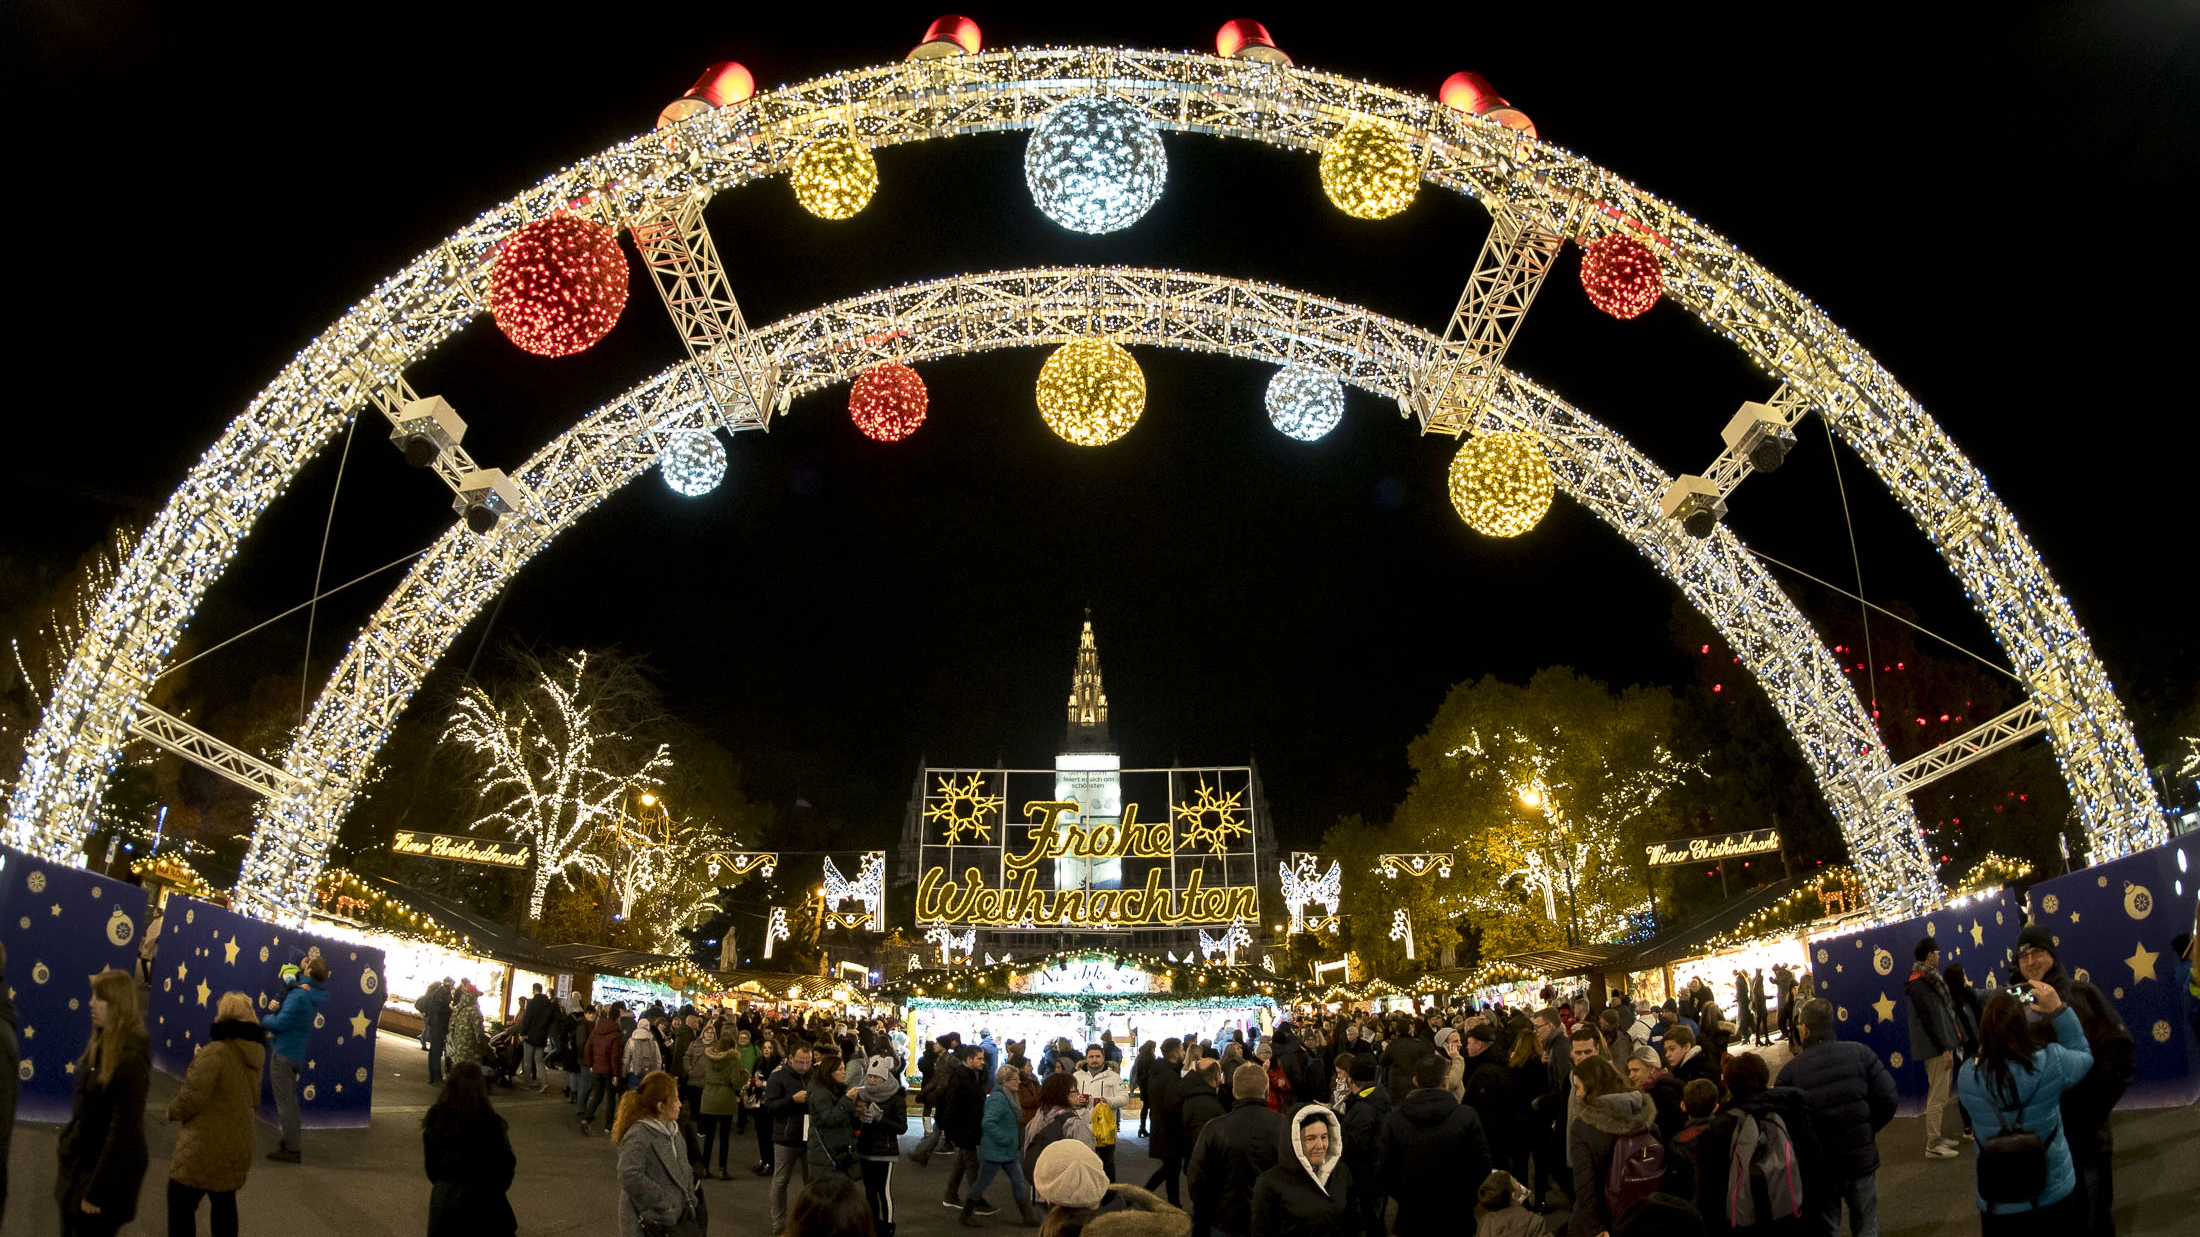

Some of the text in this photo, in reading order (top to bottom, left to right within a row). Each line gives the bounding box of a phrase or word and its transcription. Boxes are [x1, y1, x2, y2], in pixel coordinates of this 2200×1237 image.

[393, 832, 531, 867] Wiener Christkindlmarkt
[1004, 801, 1175, 869] Frohe
[1646, 831, 1779, 865] Wiener Christkindlmarkt
[916, 867, 1260, 924] Weihnachten
